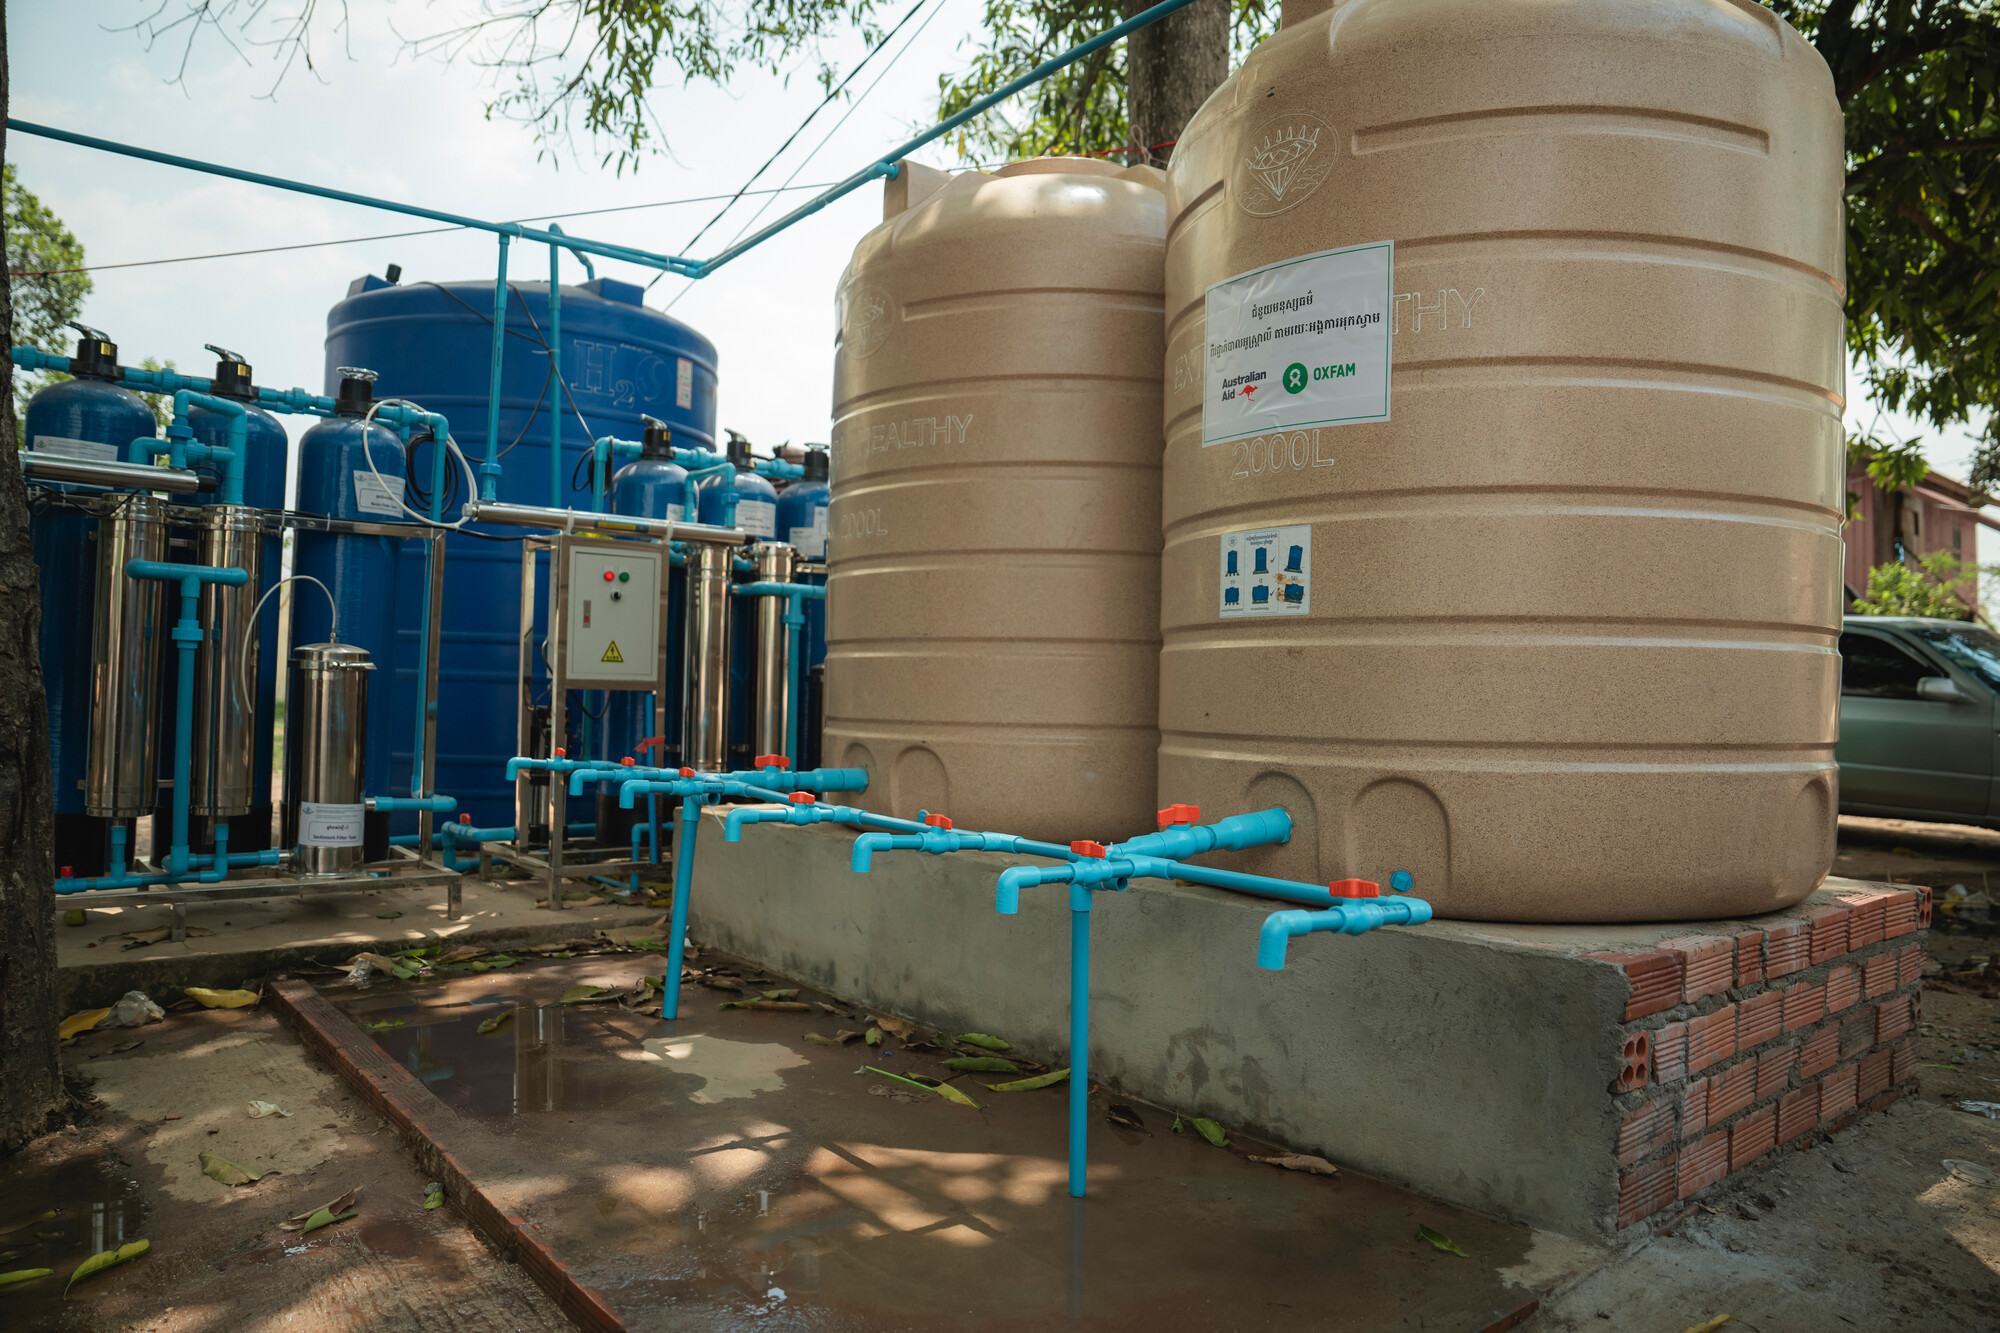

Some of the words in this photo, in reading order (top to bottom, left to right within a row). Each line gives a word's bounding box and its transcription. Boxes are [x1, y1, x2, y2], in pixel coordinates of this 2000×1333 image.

[1222, 370, 1267, 389] Australian
[1313, 363, 1356, 381] OXFAM
[1221, 388, 1236, 401] Aid
[1231, 429, 1334, 480] 2000L
